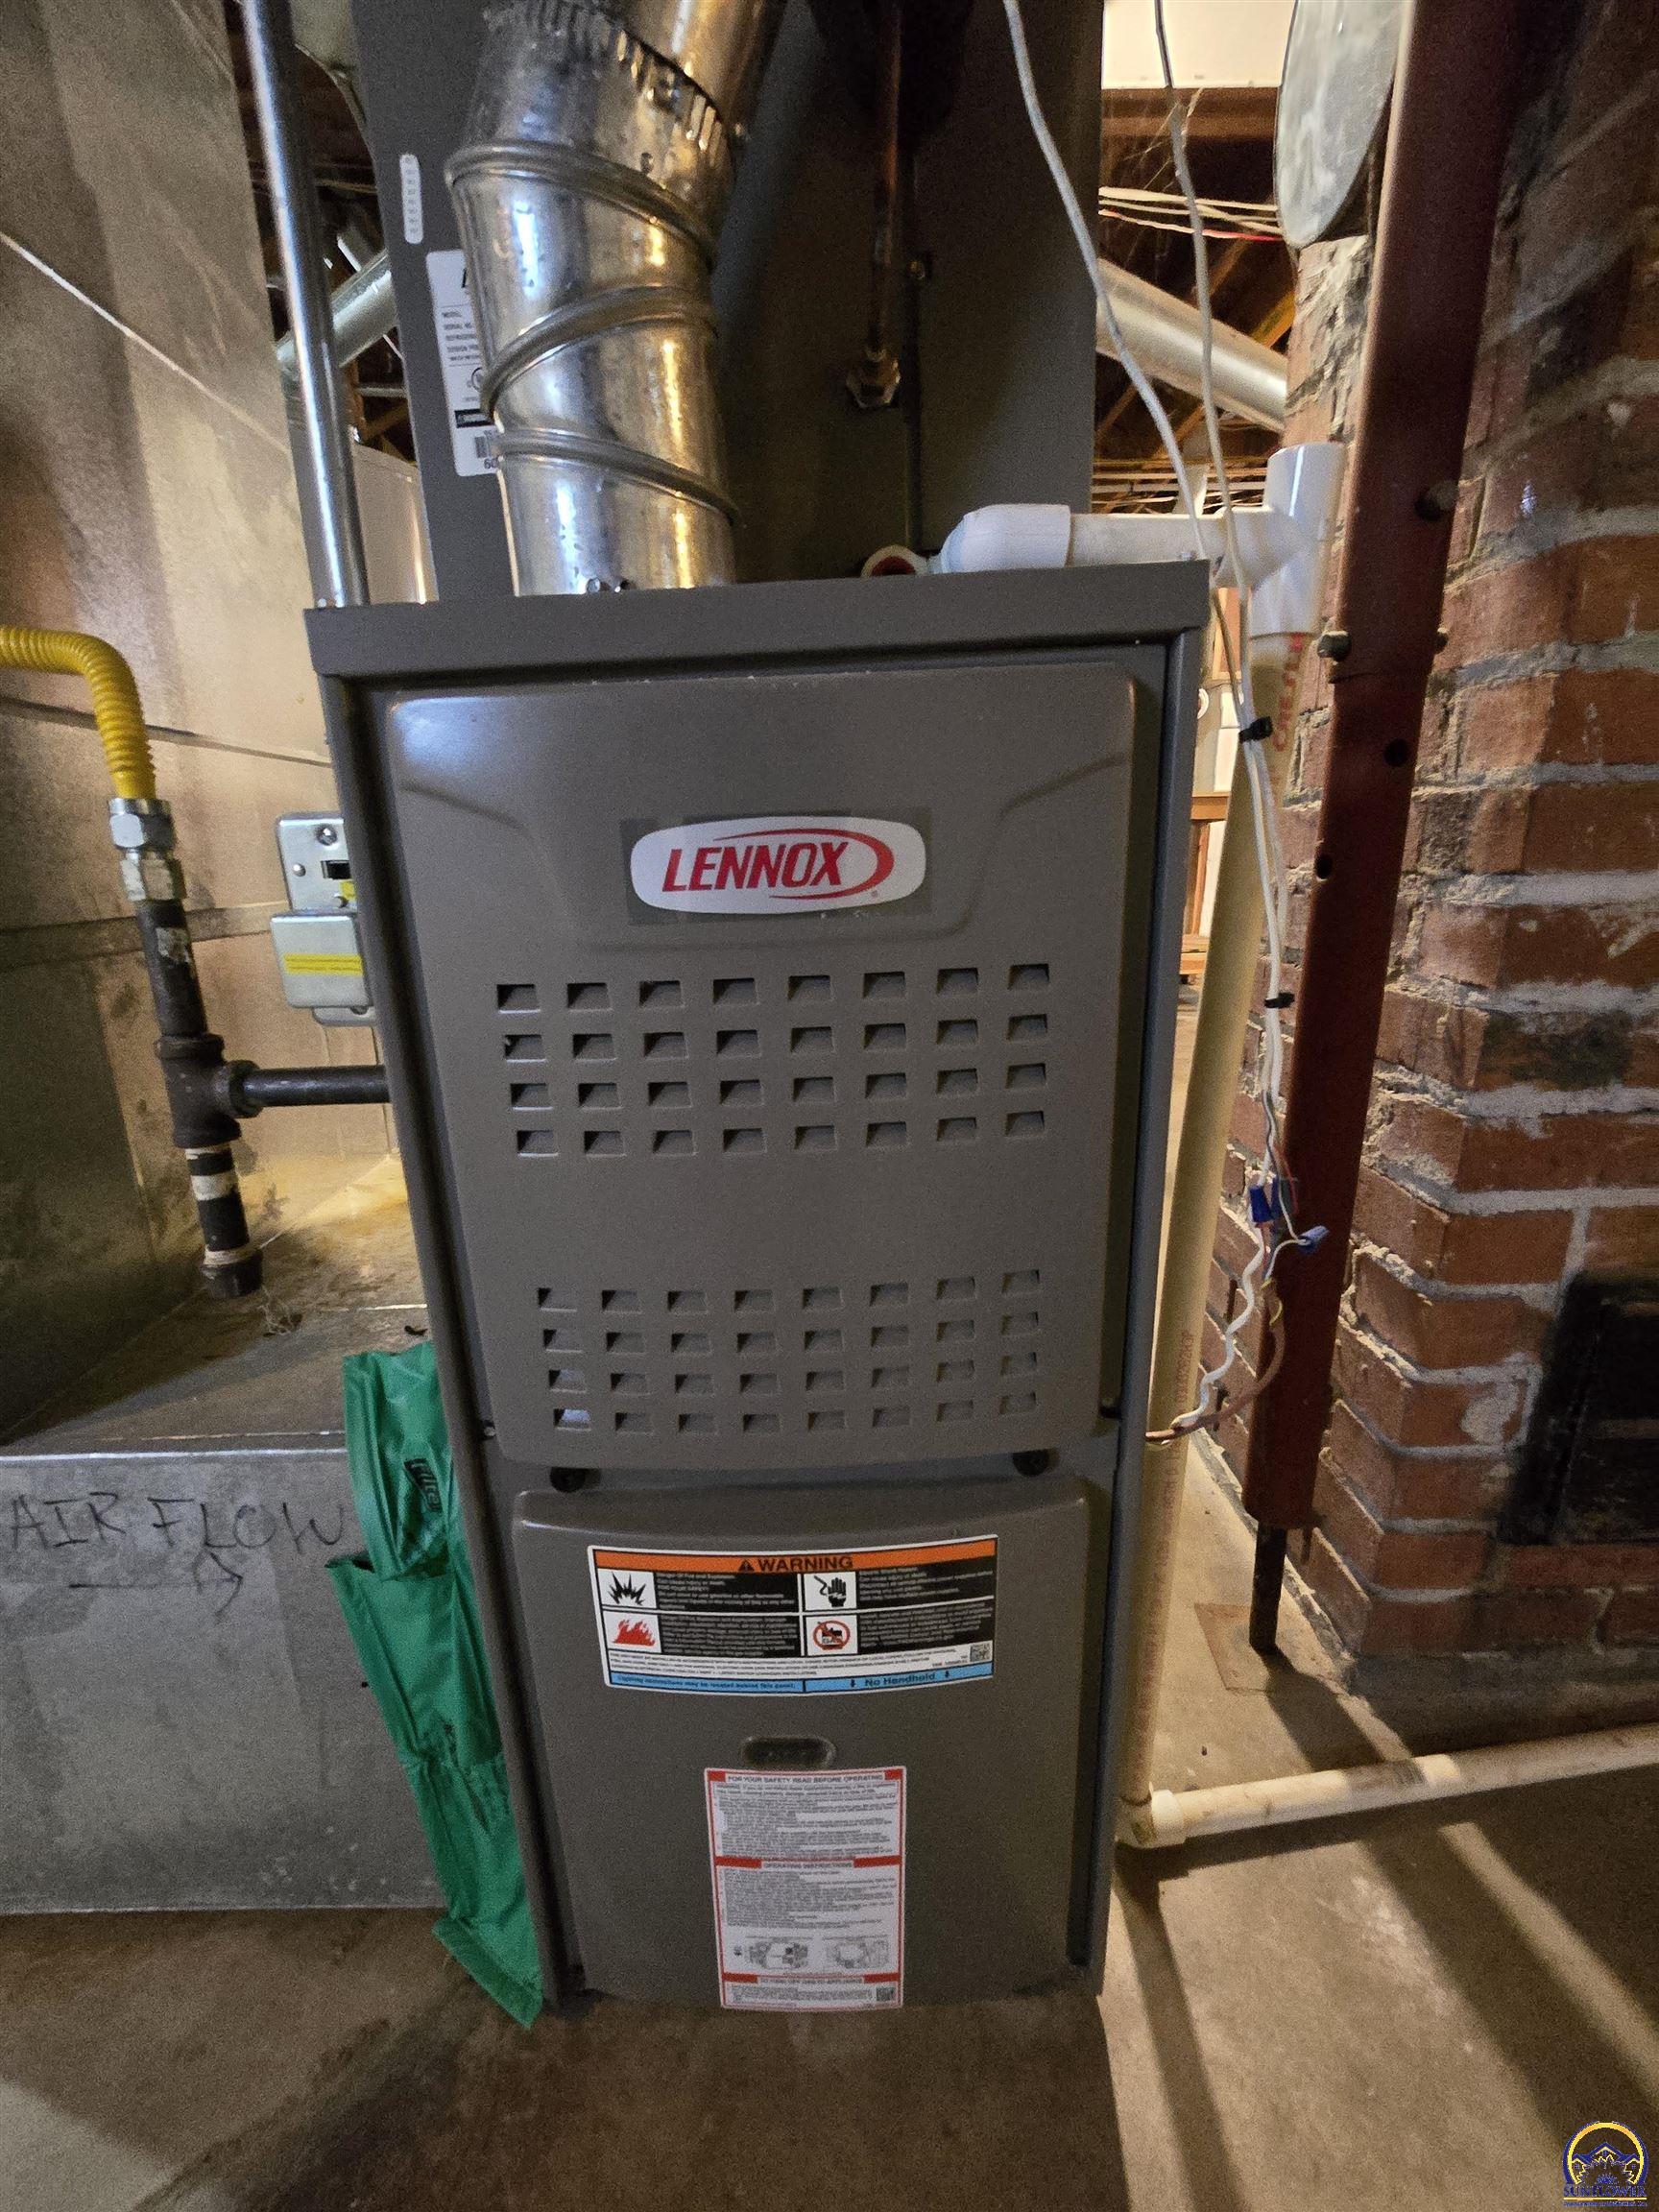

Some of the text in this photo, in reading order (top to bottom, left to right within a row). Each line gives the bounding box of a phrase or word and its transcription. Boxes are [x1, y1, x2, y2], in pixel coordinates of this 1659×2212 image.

[661, 841, 848, 892] LENNOX
[9, 1491, 346, 1554] AIR FLOW
[757, 1556, 853, 1572] WARNING
[882, 1671, 936, 1685] Handhold
